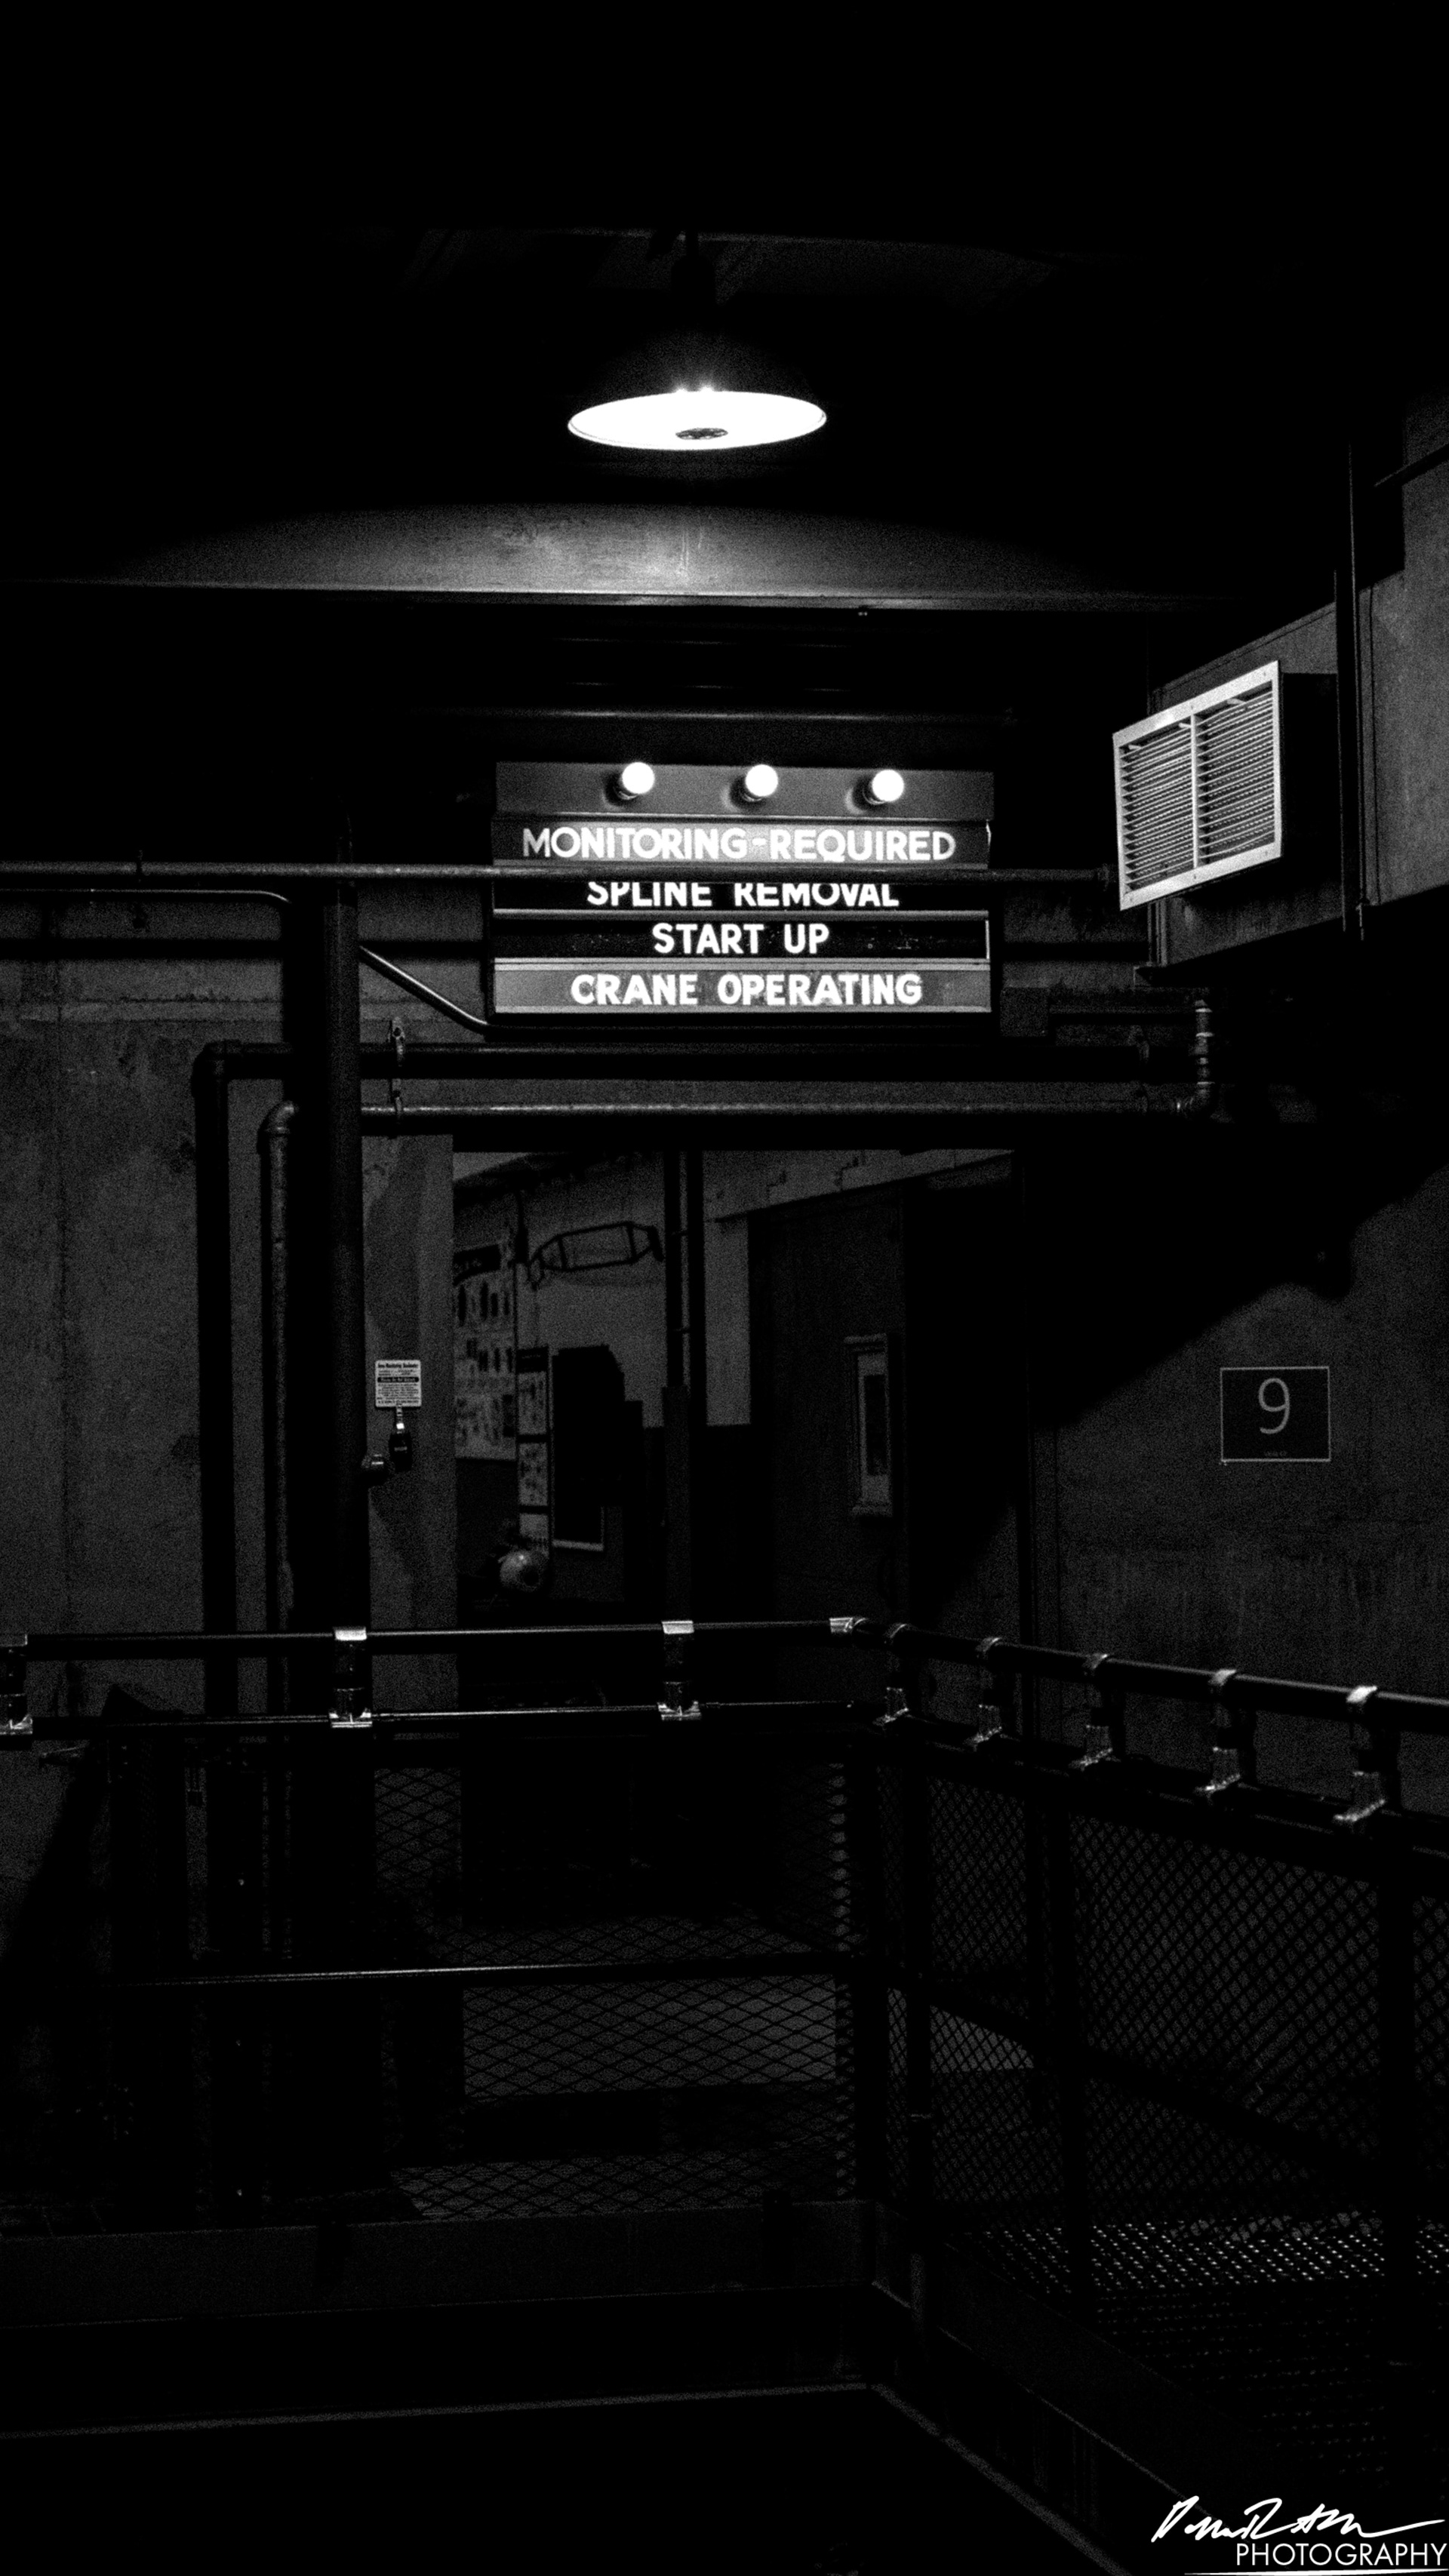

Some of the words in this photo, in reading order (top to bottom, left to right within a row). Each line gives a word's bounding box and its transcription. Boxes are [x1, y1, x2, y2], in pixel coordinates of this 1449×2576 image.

[587, 881, 712, 907] SPLINE
[734, 882, 900, 907] REMOVAL
[652, 922, 764, 954] START
[784, 923, 829, 954] UP
[571, 973, 699, 1006] CRANE
[717, 973, 923, 1006] OPERATING
[1258, 1377, 1291, 1434] 9
